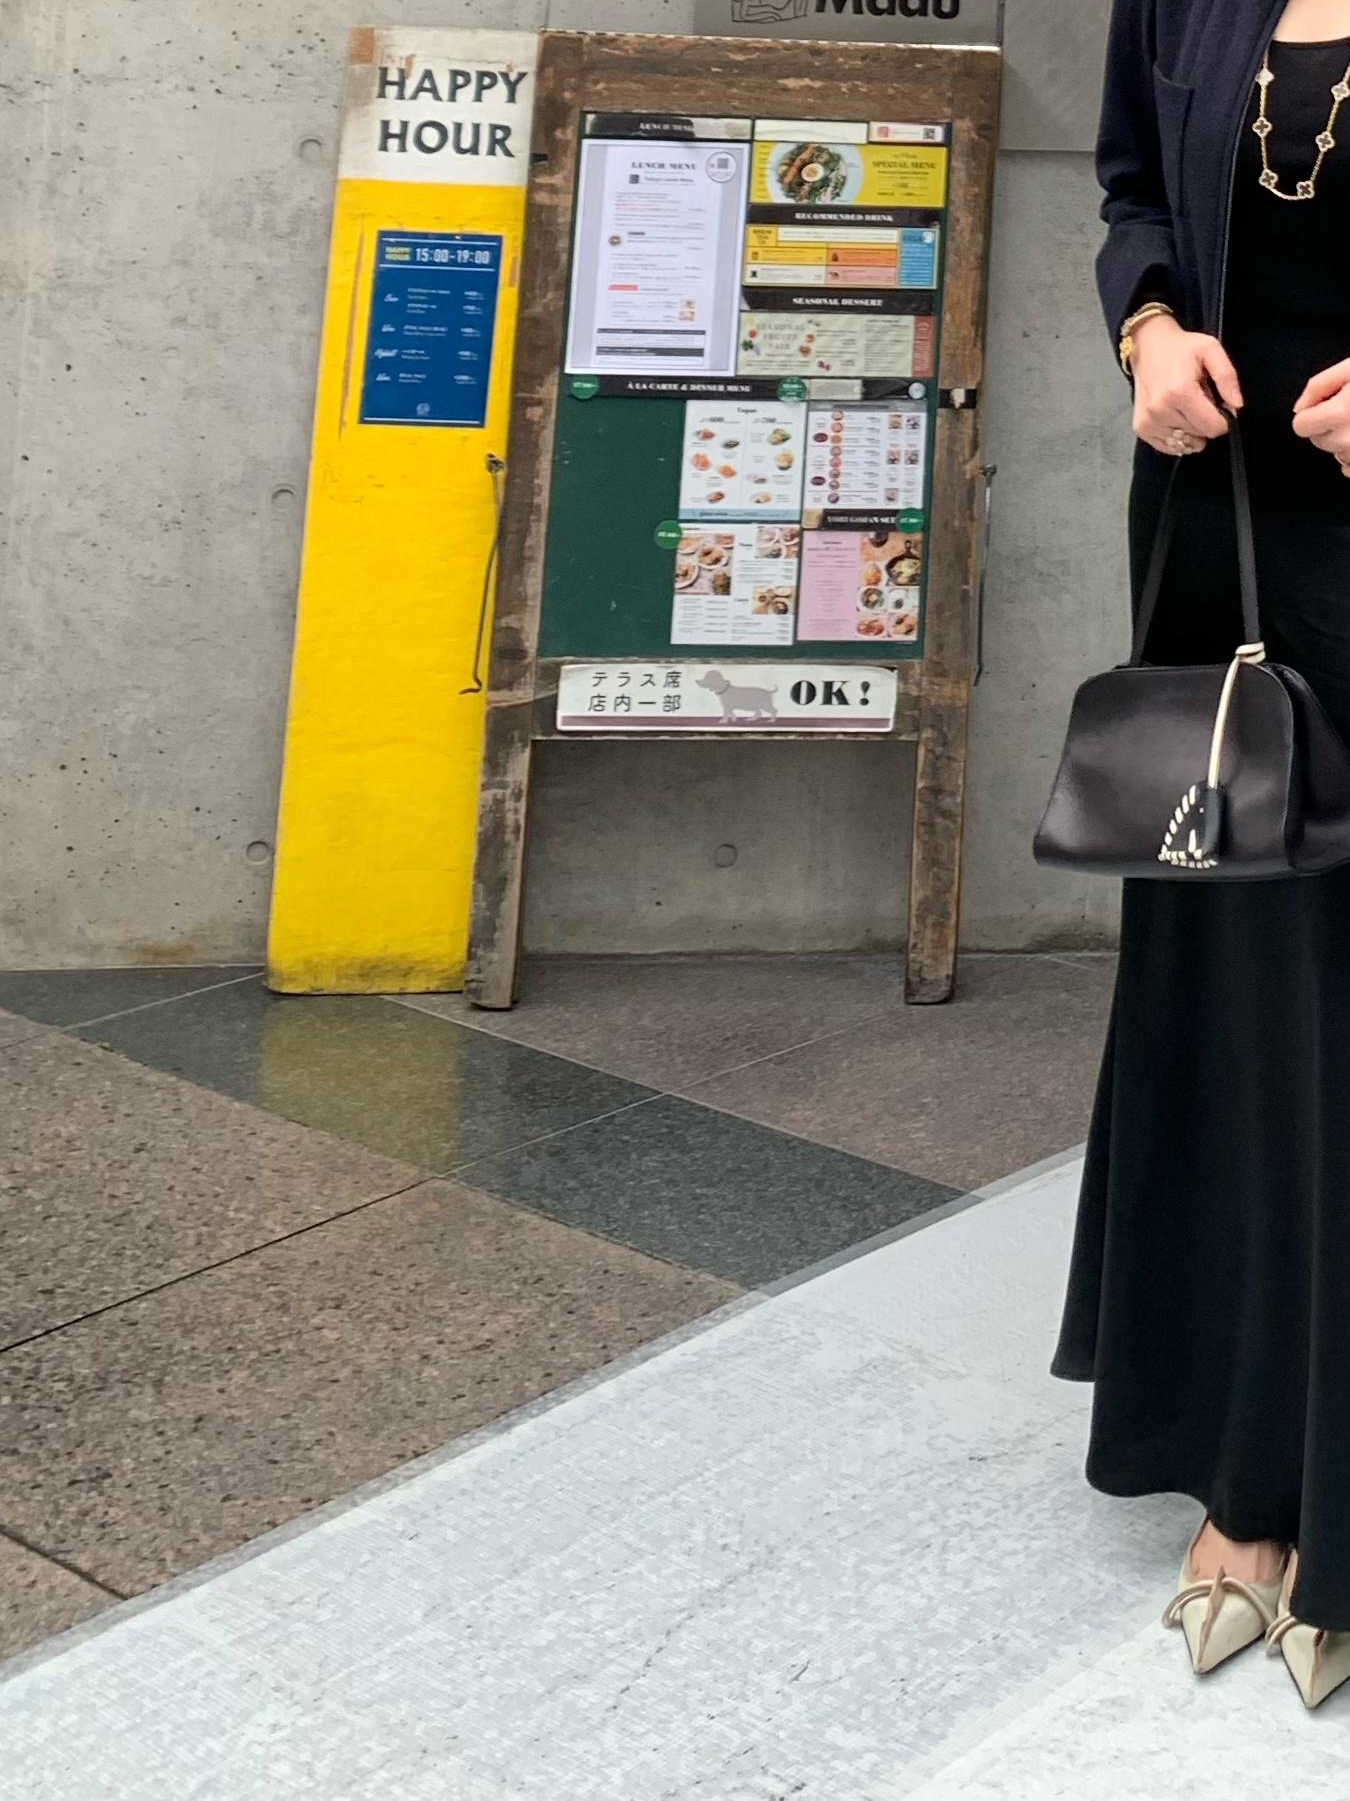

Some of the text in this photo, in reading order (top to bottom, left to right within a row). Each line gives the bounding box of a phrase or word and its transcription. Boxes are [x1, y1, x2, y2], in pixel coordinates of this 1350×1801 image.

[376, 66, 529, 104] HAPPY
[377, 119, 516, 158] HOUR
[631, 161, 697, 171] LUNCH MENU
[872, 160, 937, 170] SPECIAL MENU
[794, 212, 893, 223] RECOMMENDED DRINK
[792, 297, 883, 307] SEASONAL DESSERT
[649, 383, 679, 392] CARTE
[590, 670, 683, 689] テラス席
[789, 679, 871, 706] OK!
[587, 694, 683, 713] 店内一部
